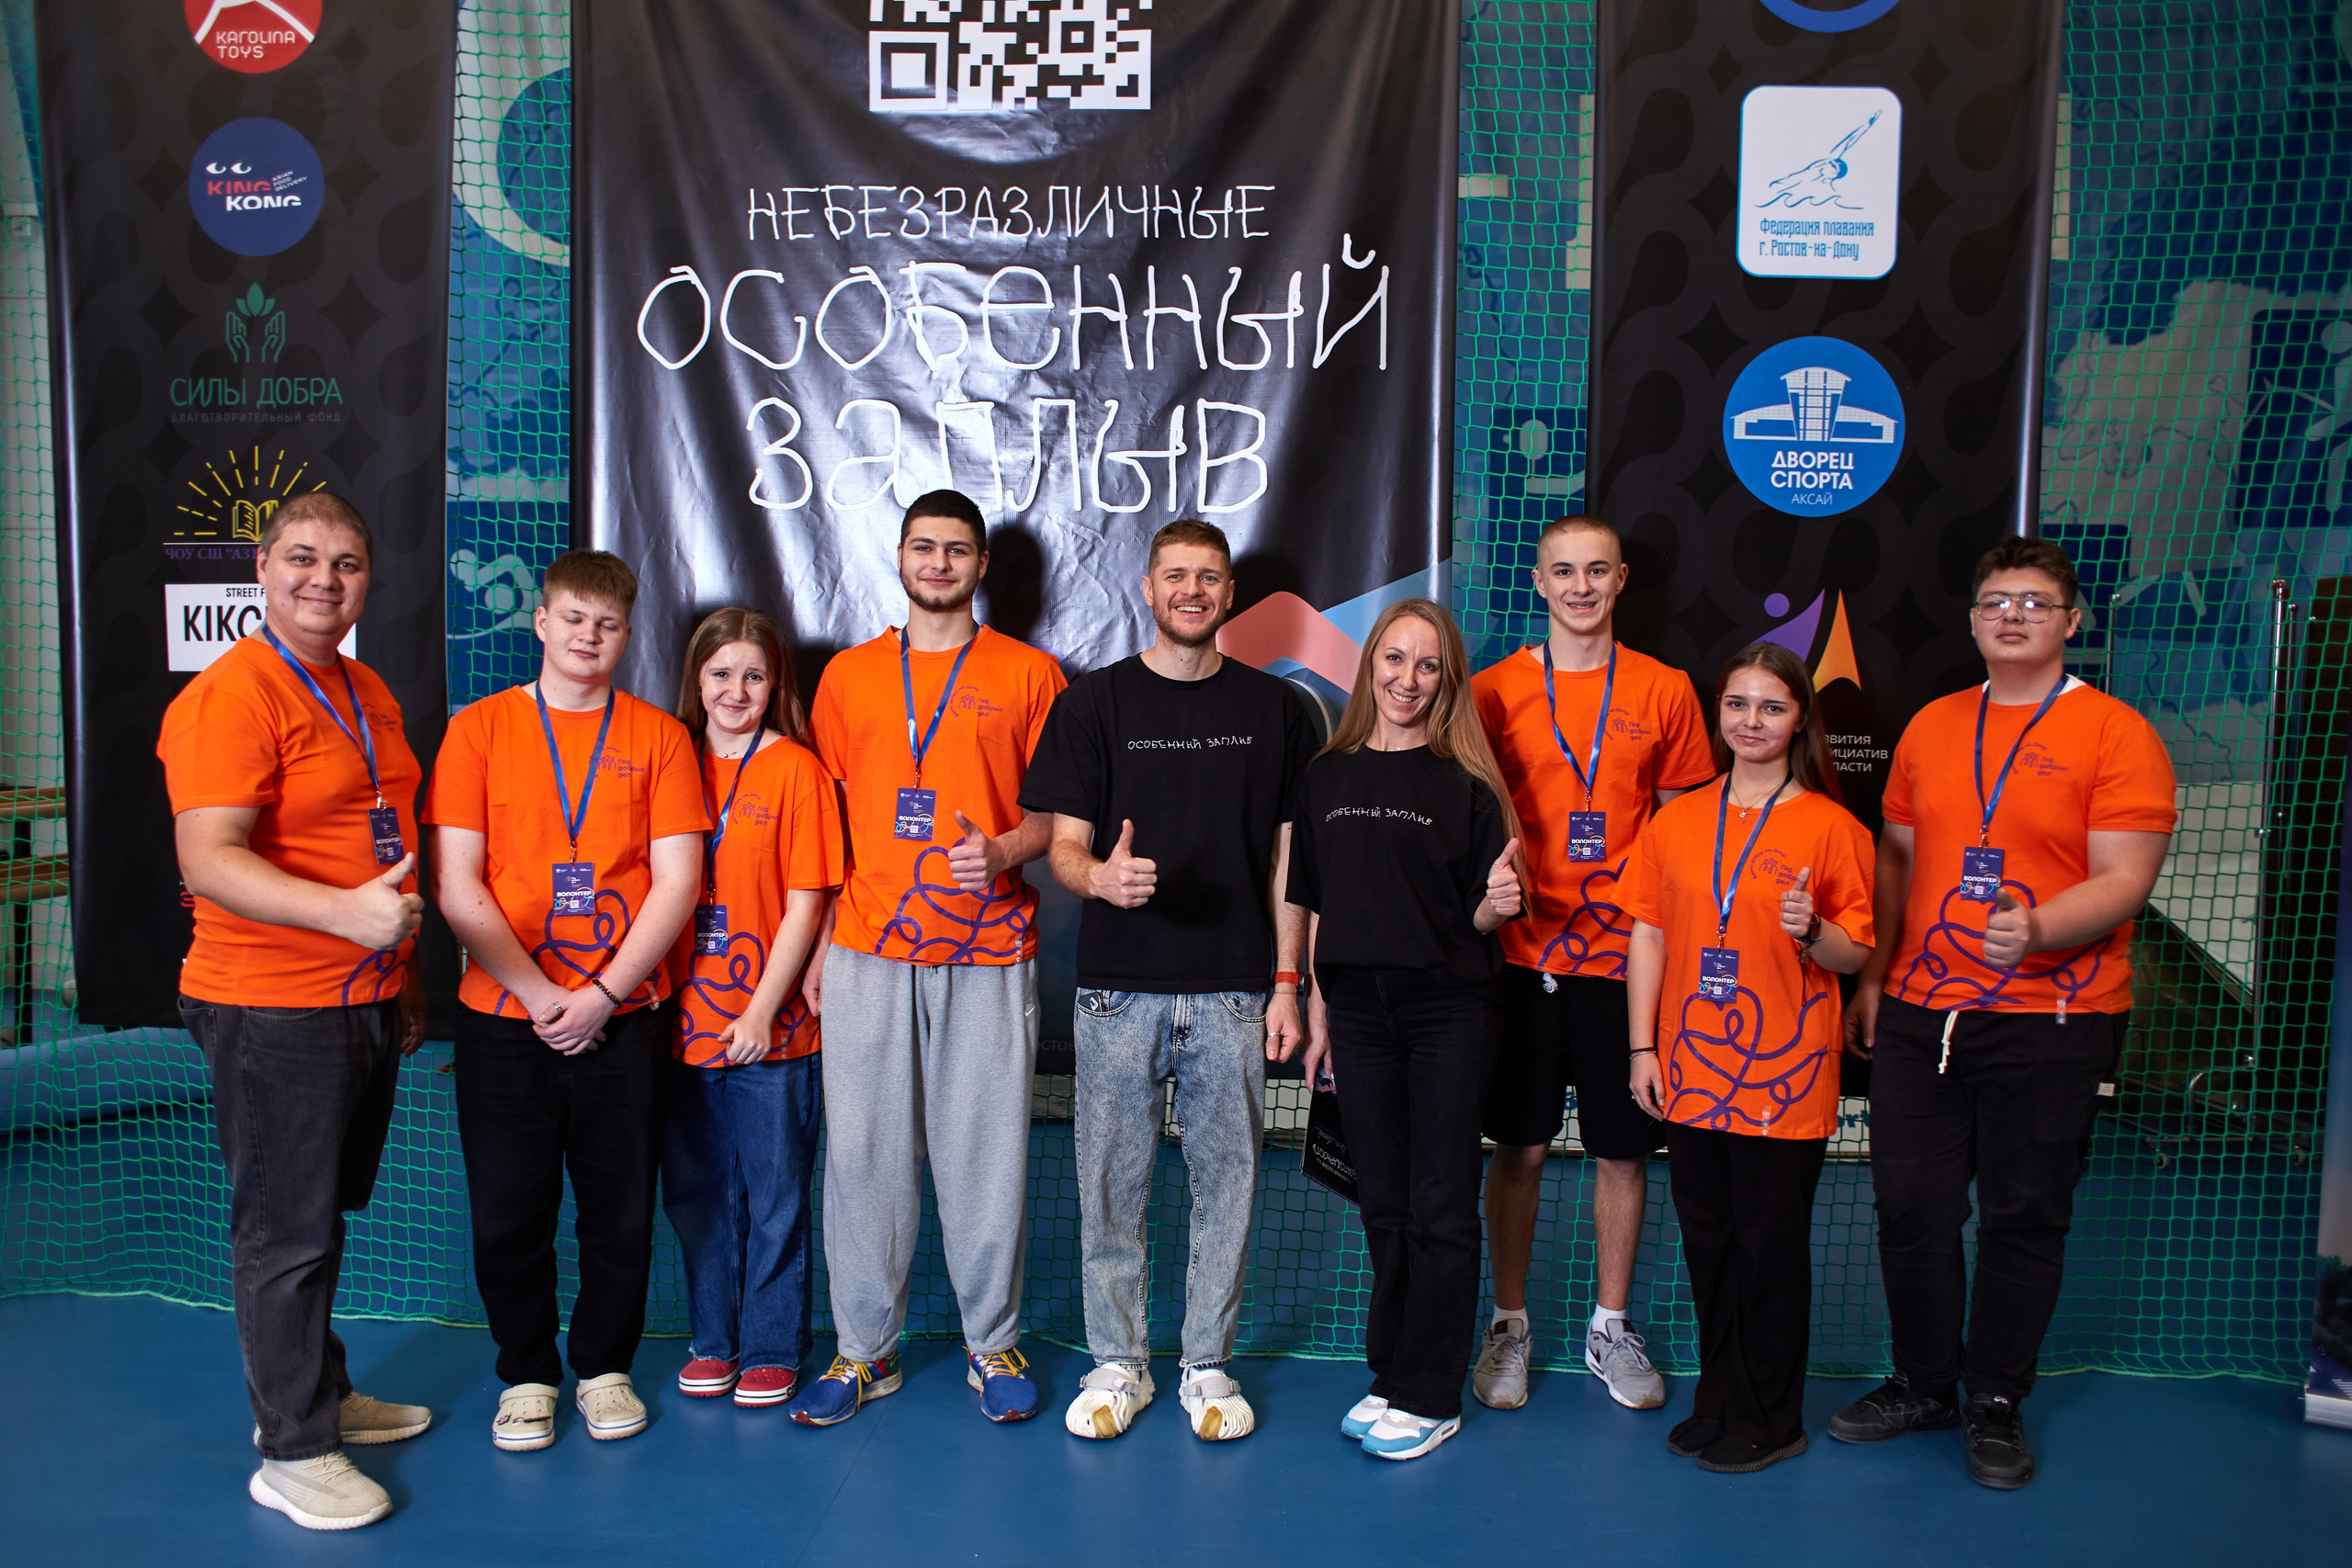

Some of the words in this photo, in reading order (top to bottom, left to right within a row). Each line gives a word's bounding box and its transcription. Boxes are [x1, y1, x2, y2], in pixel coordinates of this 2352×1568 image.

[217, 46, 265, 59] TOYS
[272, 171, 294, 182] ASIAN
[273, 177, 292, 186] FOOD
[207, 181, 272, 196] KING
[275, 176, 308, 192] DELIVERY
[226, 196, 302, 211] KONG
[748, 185, 1276, 241] НЕБЕЗРАЗЛИЧНЫЕ
[1759, 218, 1821, 238] Федерация
[1824, 220, 1874, 236] плавания
[1758, 242, 1769, 255] г.
[1770, 240, 1859, 261] Ростов-на-Дону
[170, 378, 246, 408] СИЛЫ
[256, 377, 344, 410] ДОБРА
[172, 412, 301, 423] БЛАГОТВОРИТЕЛЬНЫЙ
[308, 412, 341, 423] ФОНД
[1771, 450, 1854, 470] ДВОРЕЦ
[1770, 470, 1854, 490] СПОРТА
[1791, 491, 1833, 504] АКСАЙ
[165, 548, 195, 559] ЧОУ
[197, 548, 222, 559] СШ
[226, 588, 258, 597] STREET
[1206, 735, 1253, 748] ЗАПЛЫВ
[1825, 735, 1871, 745] ЗВИТИЯ
[1829, 749, 1889, 760] ИЦИАТИВ
[1833, 762, 1872, 772] ЛАСТИ
[899, 815, 932, 823] ВОЛОНТЕР
[1777, 872, 1797, 881] добр
[1963, 875, 1997, 884] ВОЛОНТЕР
[1702, 976, 1735, 984] ВОЛОНТЕР
